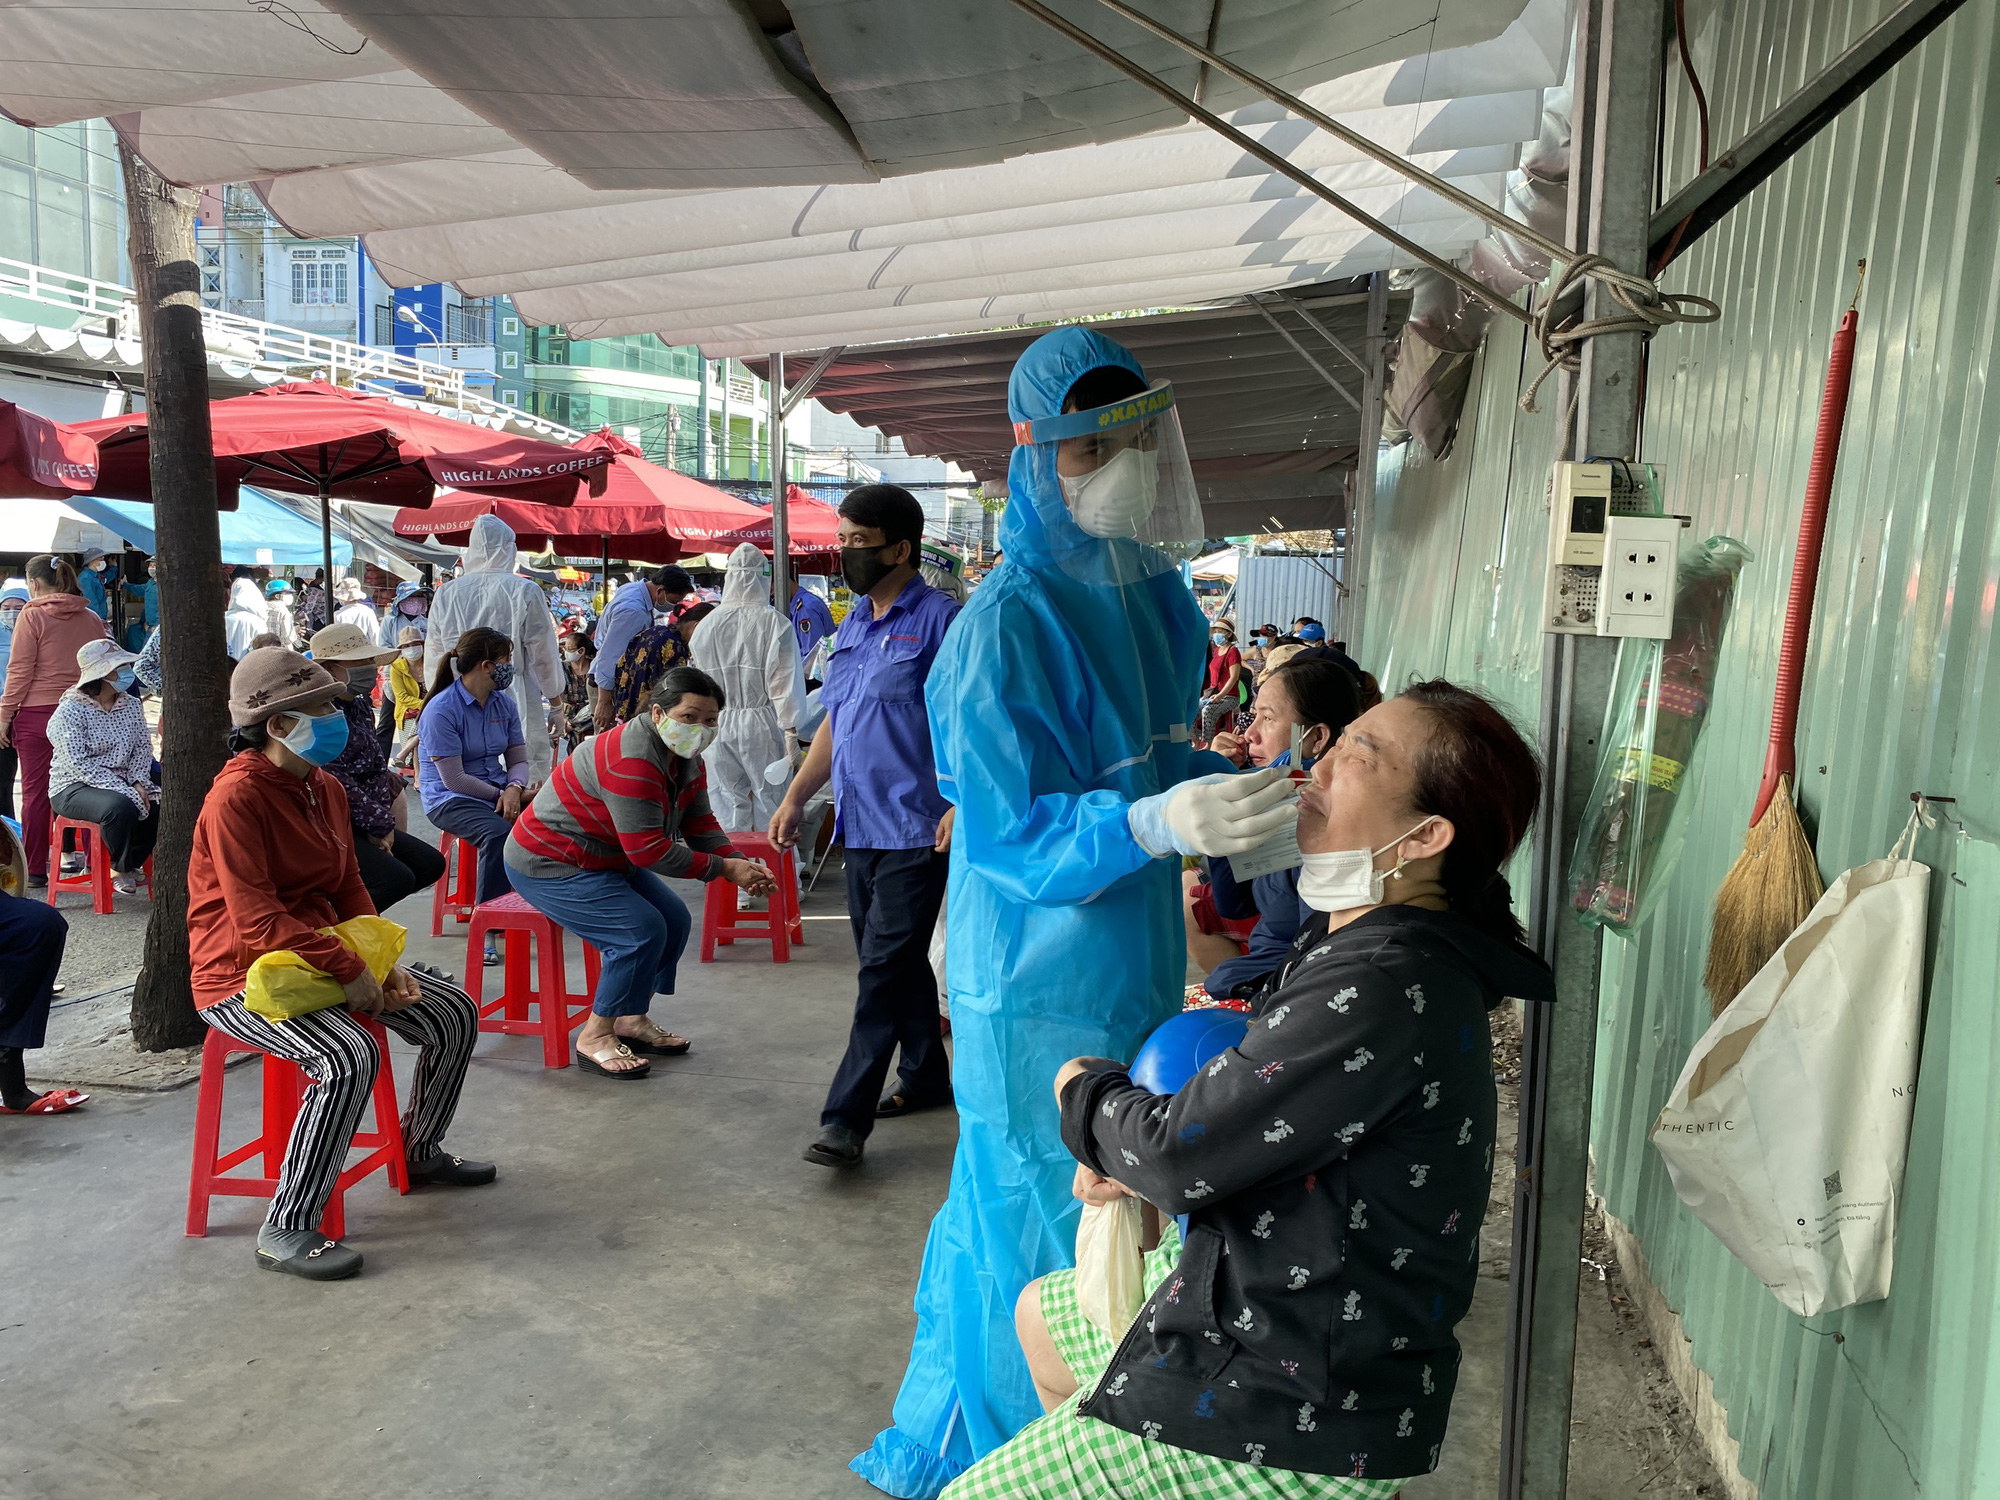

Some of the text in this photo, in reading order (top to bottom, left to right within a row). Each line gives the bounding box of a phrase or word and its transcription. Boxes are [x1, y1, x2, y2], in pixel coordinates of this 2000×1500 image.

[52, 461, 97, 478] COFFEE
[441, 456, 604, 482] HIGHLANDS COFFEE
[402, 522, 457, 531] HIGHLANDS
[674, 526, 773, 538] HIGHLANDS COFFE
[1661, 1120, 1735, 1134] THENTIC
